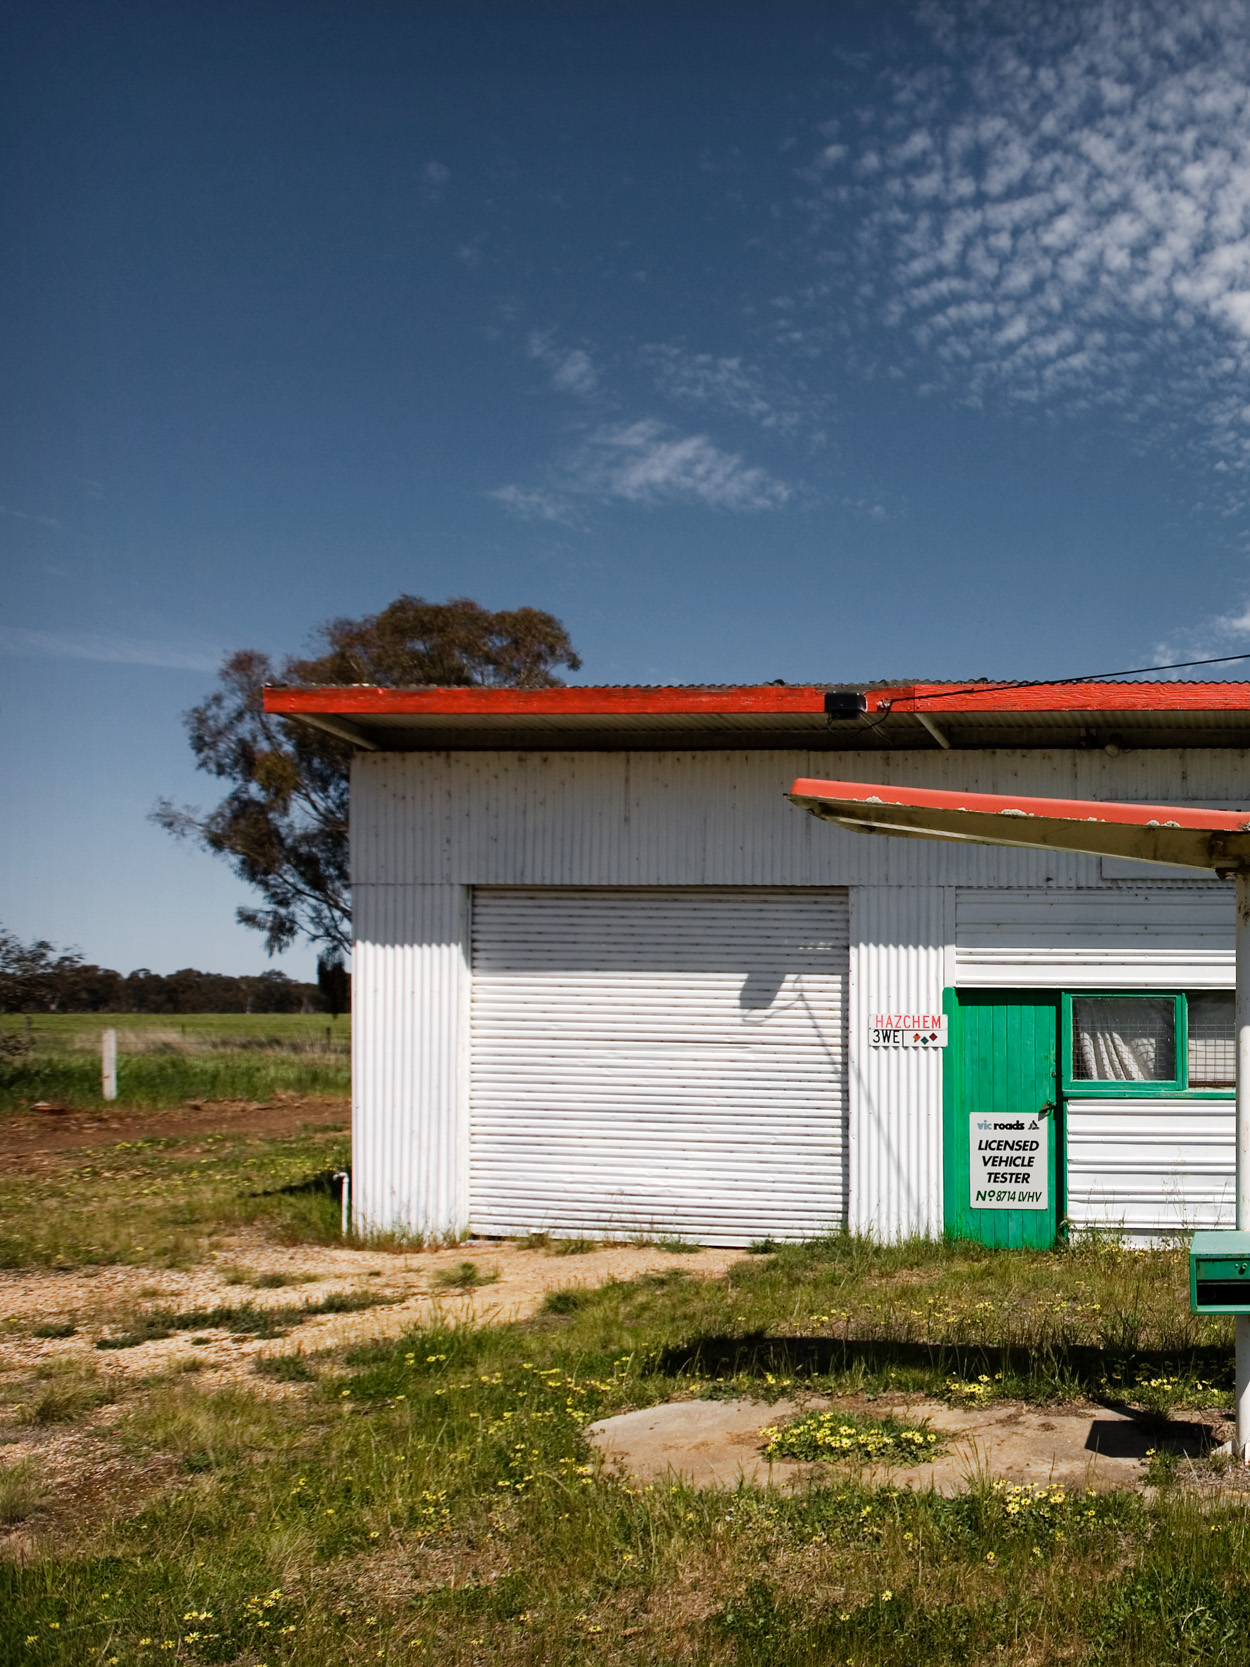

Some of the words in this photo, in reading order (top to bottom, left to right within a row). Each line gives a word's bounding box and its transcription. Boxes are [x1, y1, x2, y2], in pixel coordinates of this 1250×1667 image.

[875, 1015, 941, 1029] HAZCHEM
[872, 1029, 900, 1044] 3WE
[978, 1139, 1040, 1151] LICENSED
[982, 1155, 1035, 1167] VEHICLE
[987, 1172, 1031, 1184] TESTER
